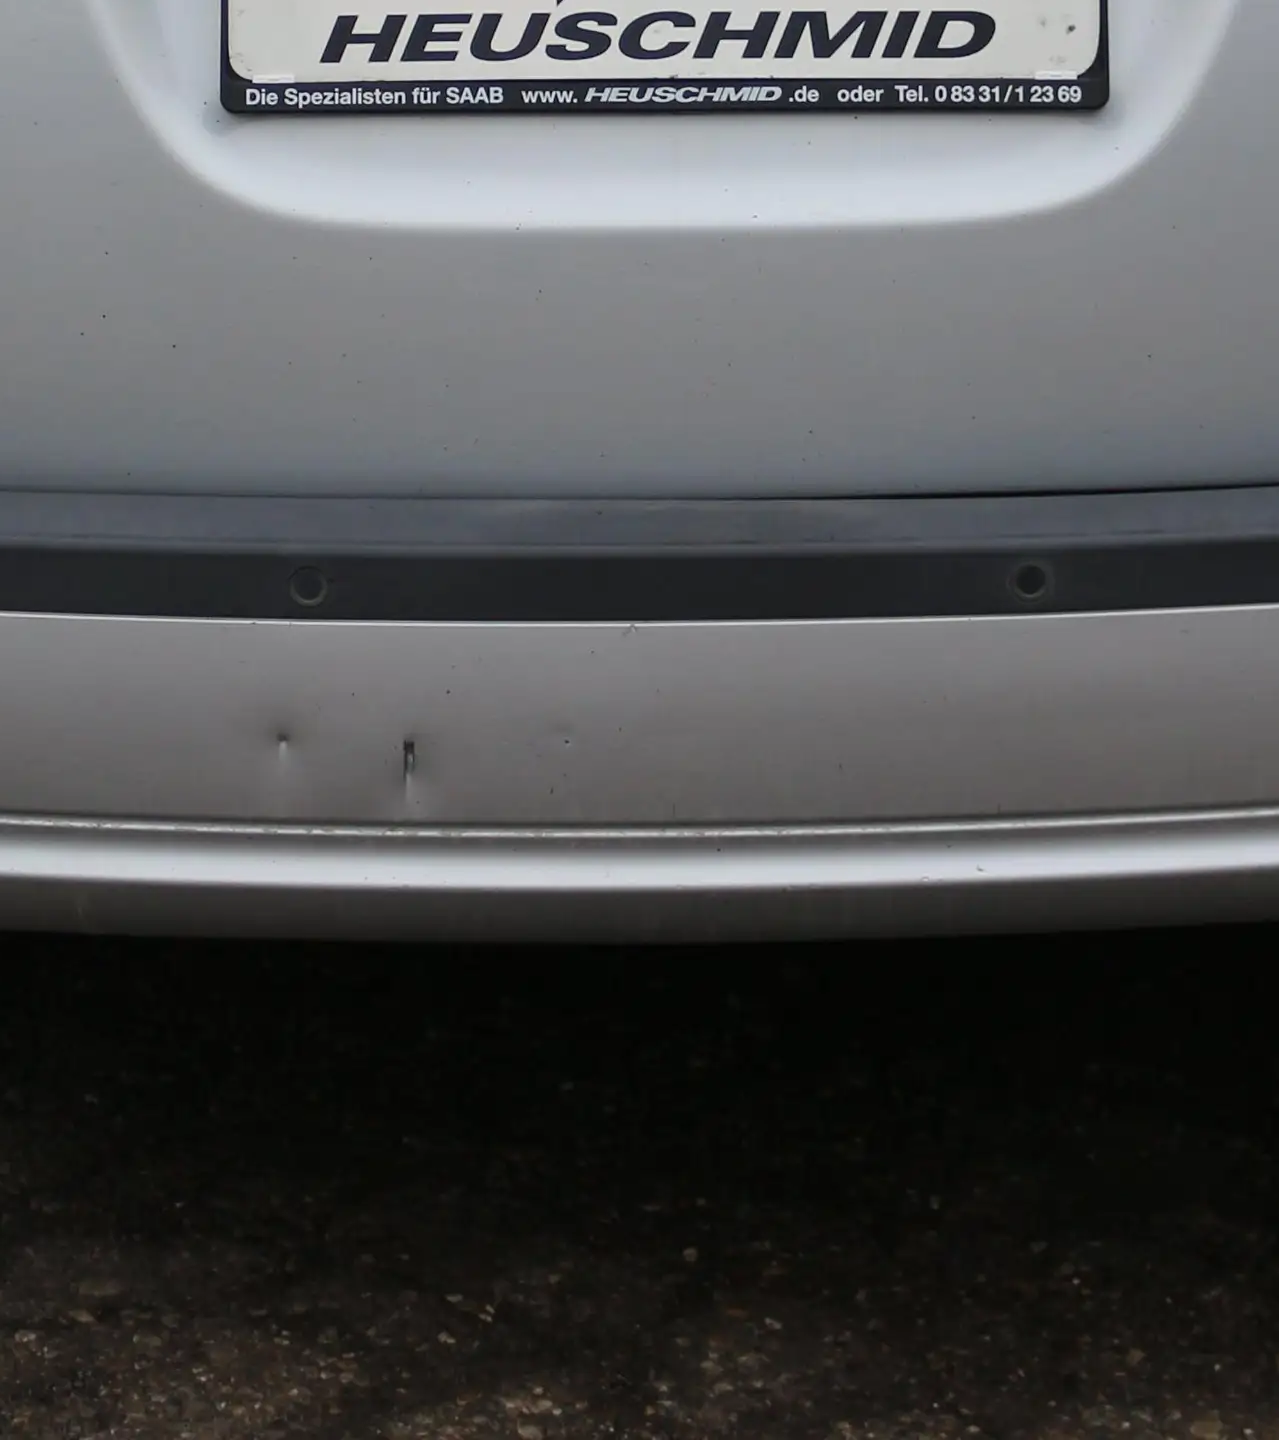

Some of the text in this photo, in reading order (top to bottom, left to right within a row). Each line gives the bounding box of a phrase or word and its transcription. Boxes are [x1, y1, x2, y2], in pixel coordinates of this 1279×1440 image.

[320, 11, 997, 63] HEUSCHMID
[245, 88, 279, 106] Die
[283, 87, 406, 109] Spezialisten
[411, 87, 441, 105] für
[445, 86, 504, 104] SAAB
[584, 86, 783, 103] HEUSCHMID
[837, 85, 885, 103] oder
[894, 85, 929, 103] Tel.
